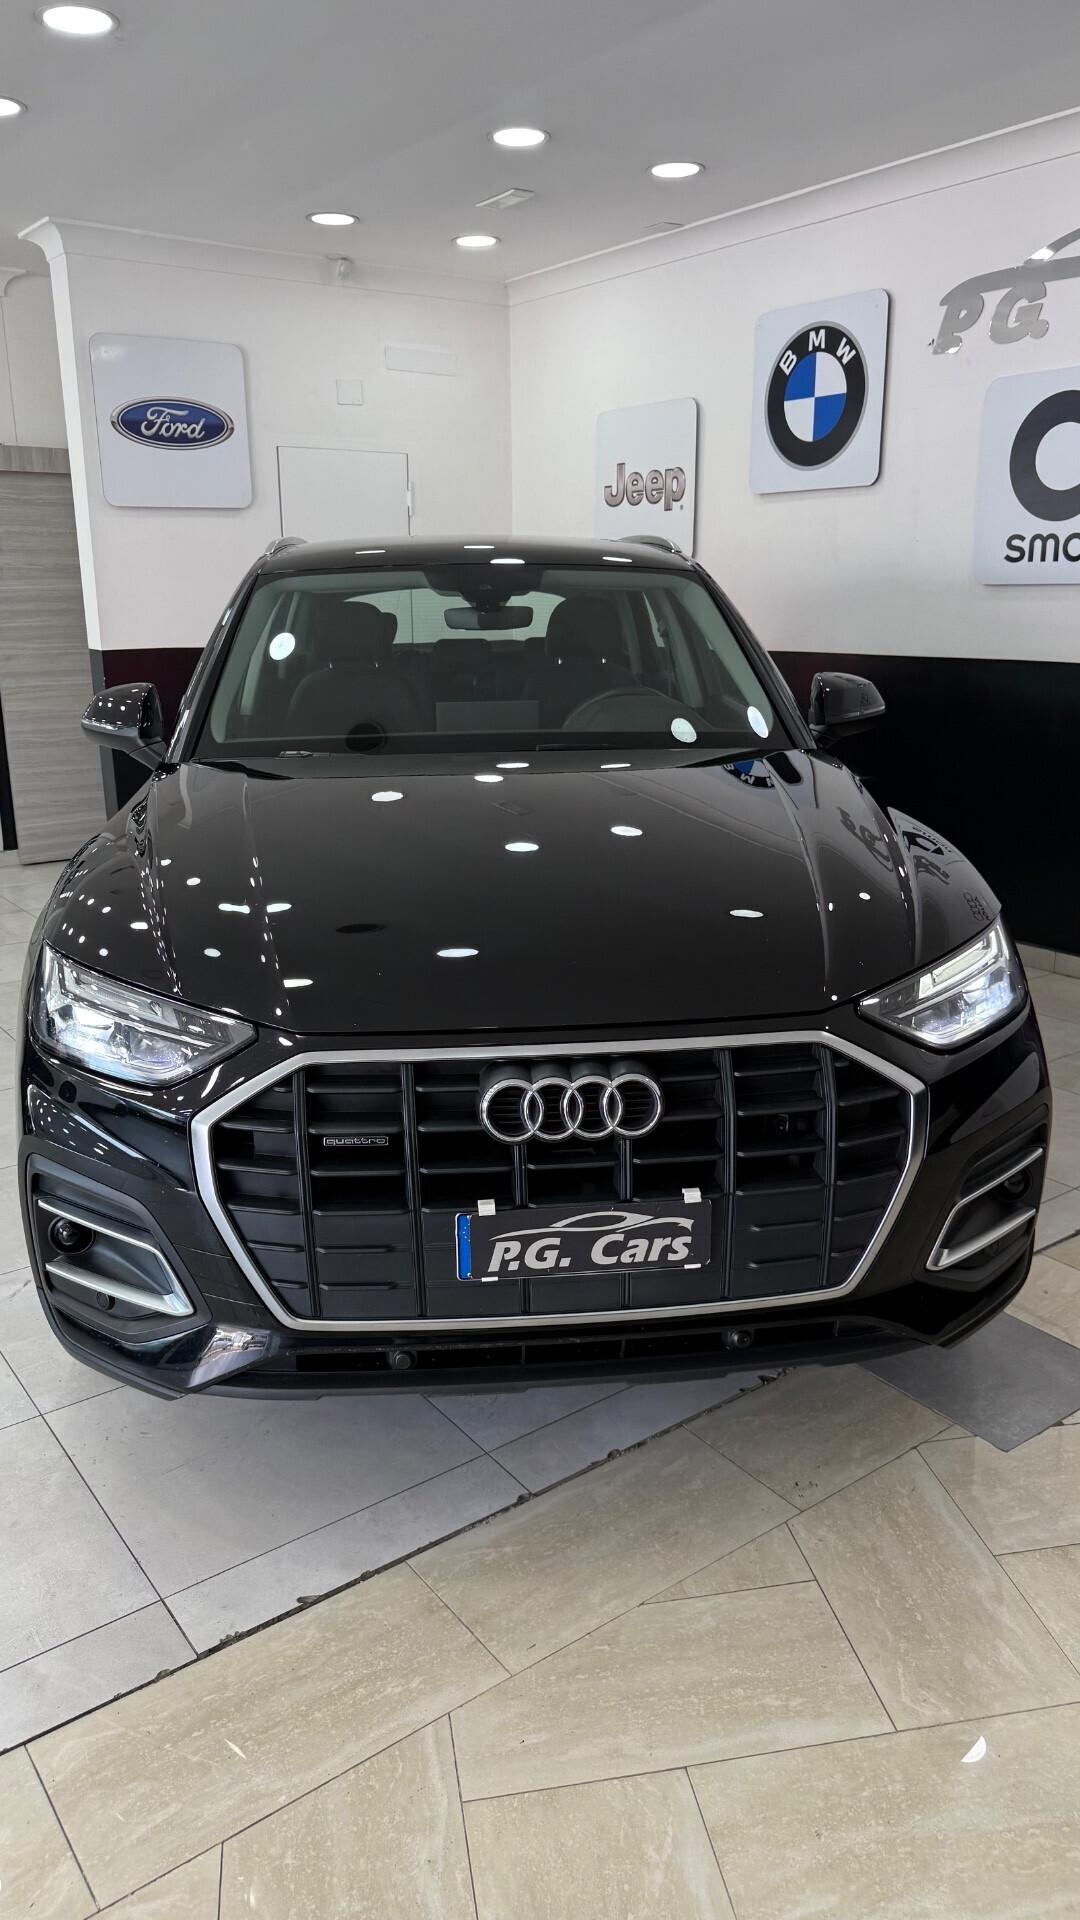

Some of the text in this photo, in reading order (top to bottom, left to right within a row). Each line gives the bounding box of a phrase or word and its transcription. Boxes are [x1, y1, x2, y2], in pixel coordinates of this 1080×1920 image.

[778, 328, 857, 377] BMW
[140, 406, 206, 439] Ford
[603, 462, 687, 512] Jeep
[325, 1137, 387, 1146] quattro
[487, 1232, 693, 1273] P.G. Cars
